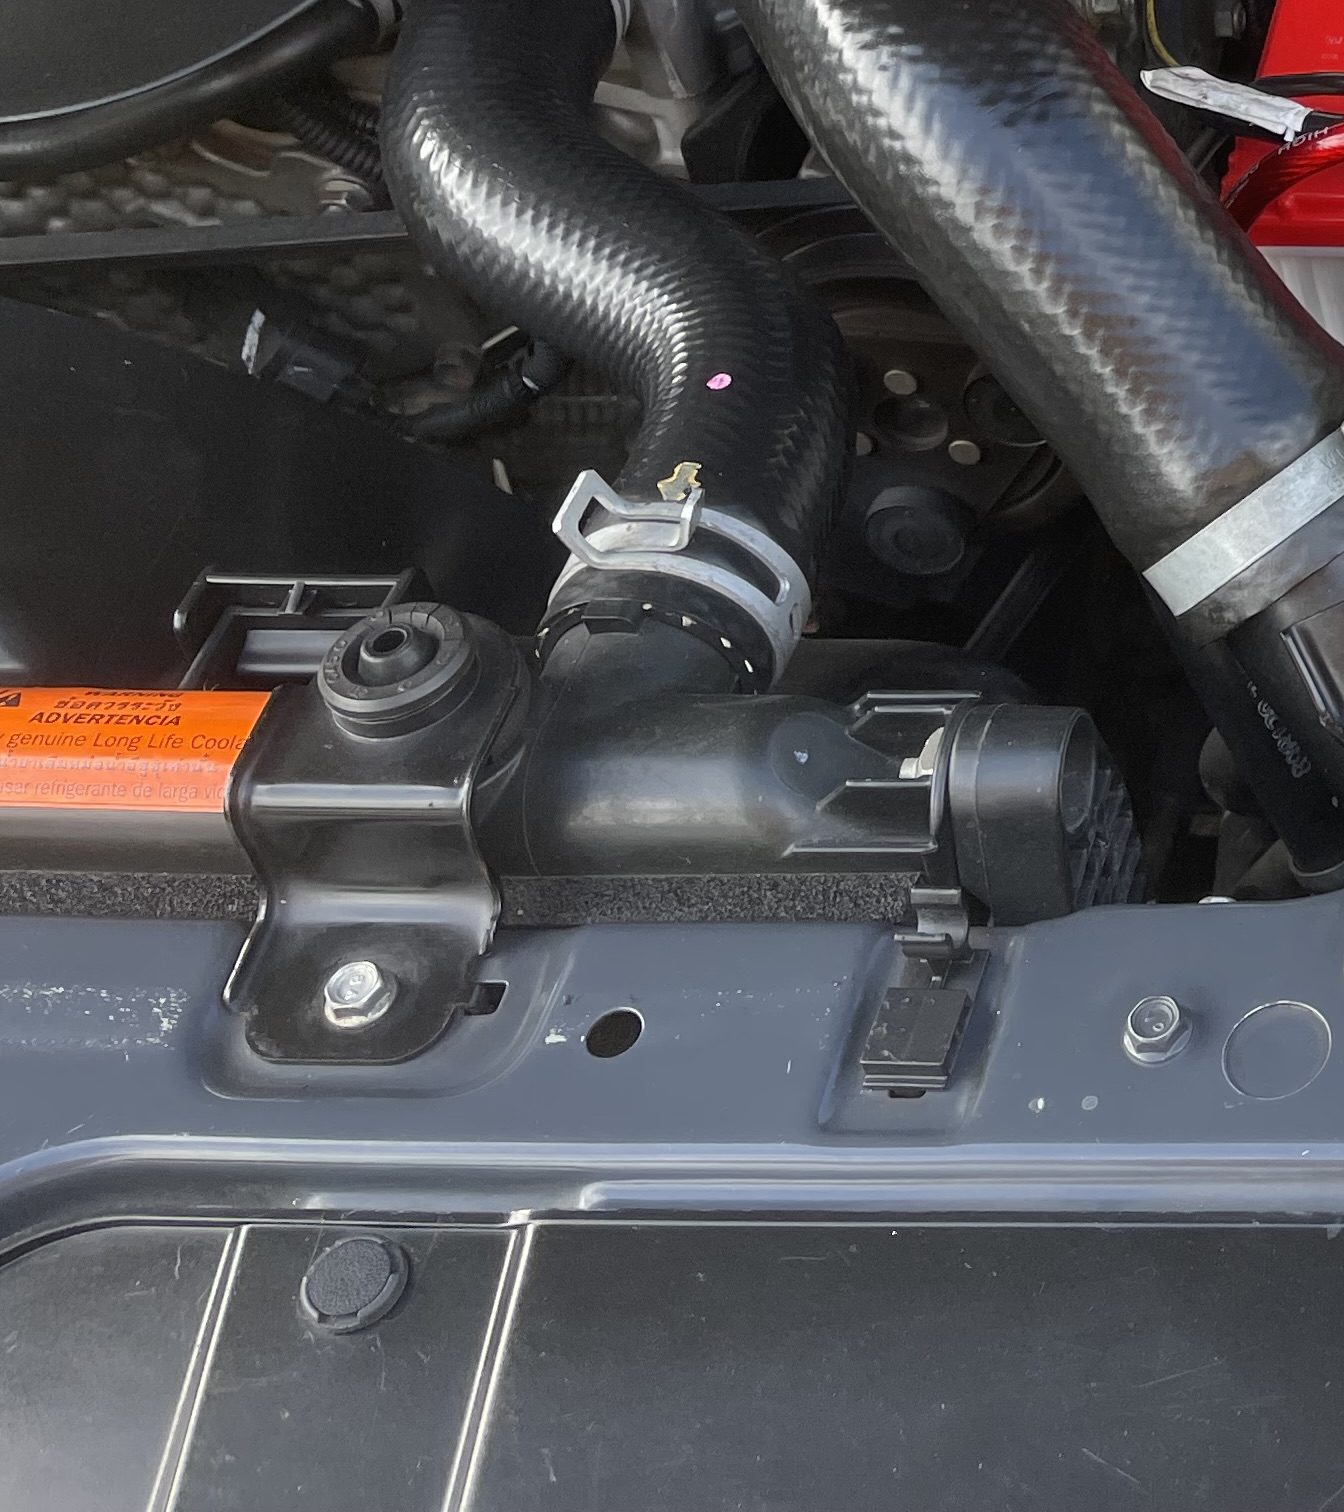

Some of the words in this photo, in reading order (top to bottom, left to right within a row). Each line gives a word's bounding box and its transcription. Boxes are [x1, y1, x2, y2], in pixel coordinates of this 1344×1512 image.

[28, 712, 181, 727] ADVERTENCIA
[6, 732, 87, 748] genuine
[93, 733, 143, 752] Long
[147, 733, 184, 749] Life
[34, 778, 127, 800] refrigerante
[132, 782, 152, 798] de
[158, 783, 197, 802] larga
